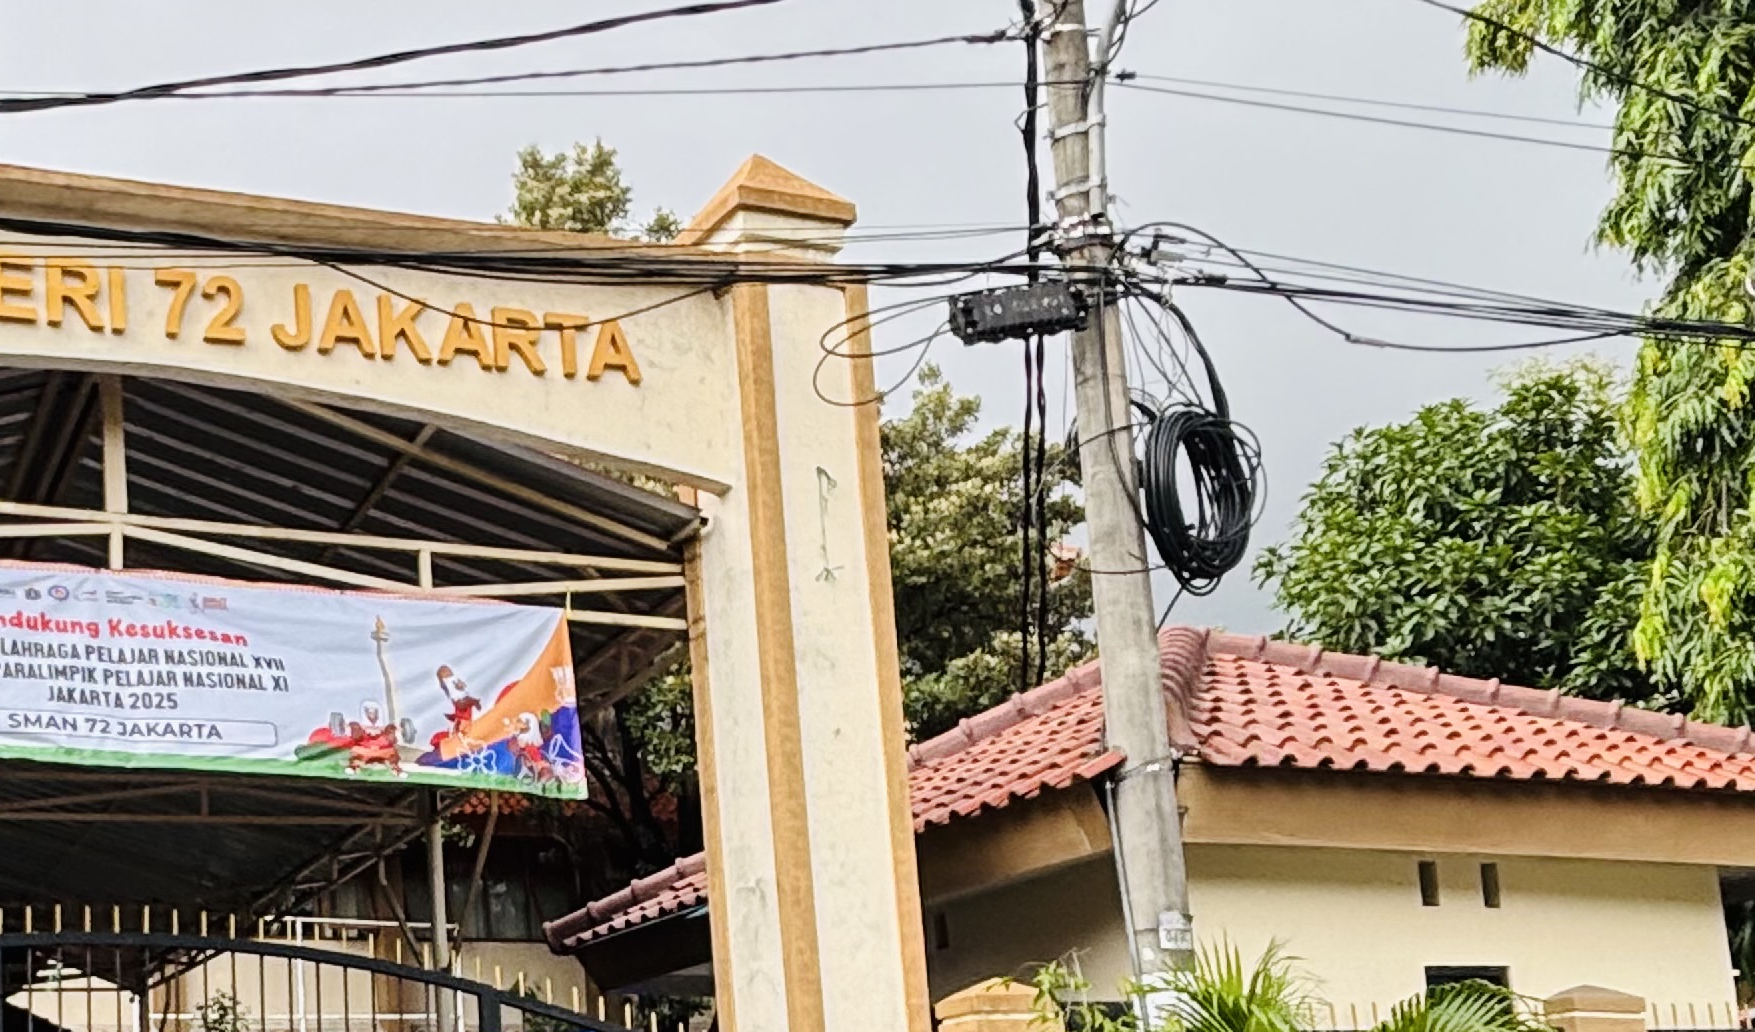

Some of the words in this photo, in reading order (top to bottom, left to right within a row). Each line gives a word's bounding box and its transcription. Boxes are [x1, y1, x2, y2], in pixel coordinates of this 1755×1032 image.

[154, 267, 246, 344] 72
[270, 282, 643, 386] JAKARTA
[107, 617, 249, 647] Kesuksesan
[84, 644, 160, 666] PELAJAR
[164, 649, 249, 669] NASIONAL
[251, 653, 286, 672] XVII
[103, 668, 179, 689] PELAJAR
[182, 671, 267, 692] NASIONAL
[271, 674, 290, 692] XI
[48, 685, 125, 709] JAKARTA
[129, 691, 178, 710] 2025
[8, 712, 78, 732] SMAN
[84, 717, 112, 735] 72
[116, 721, 224, 740] JAKARTA
